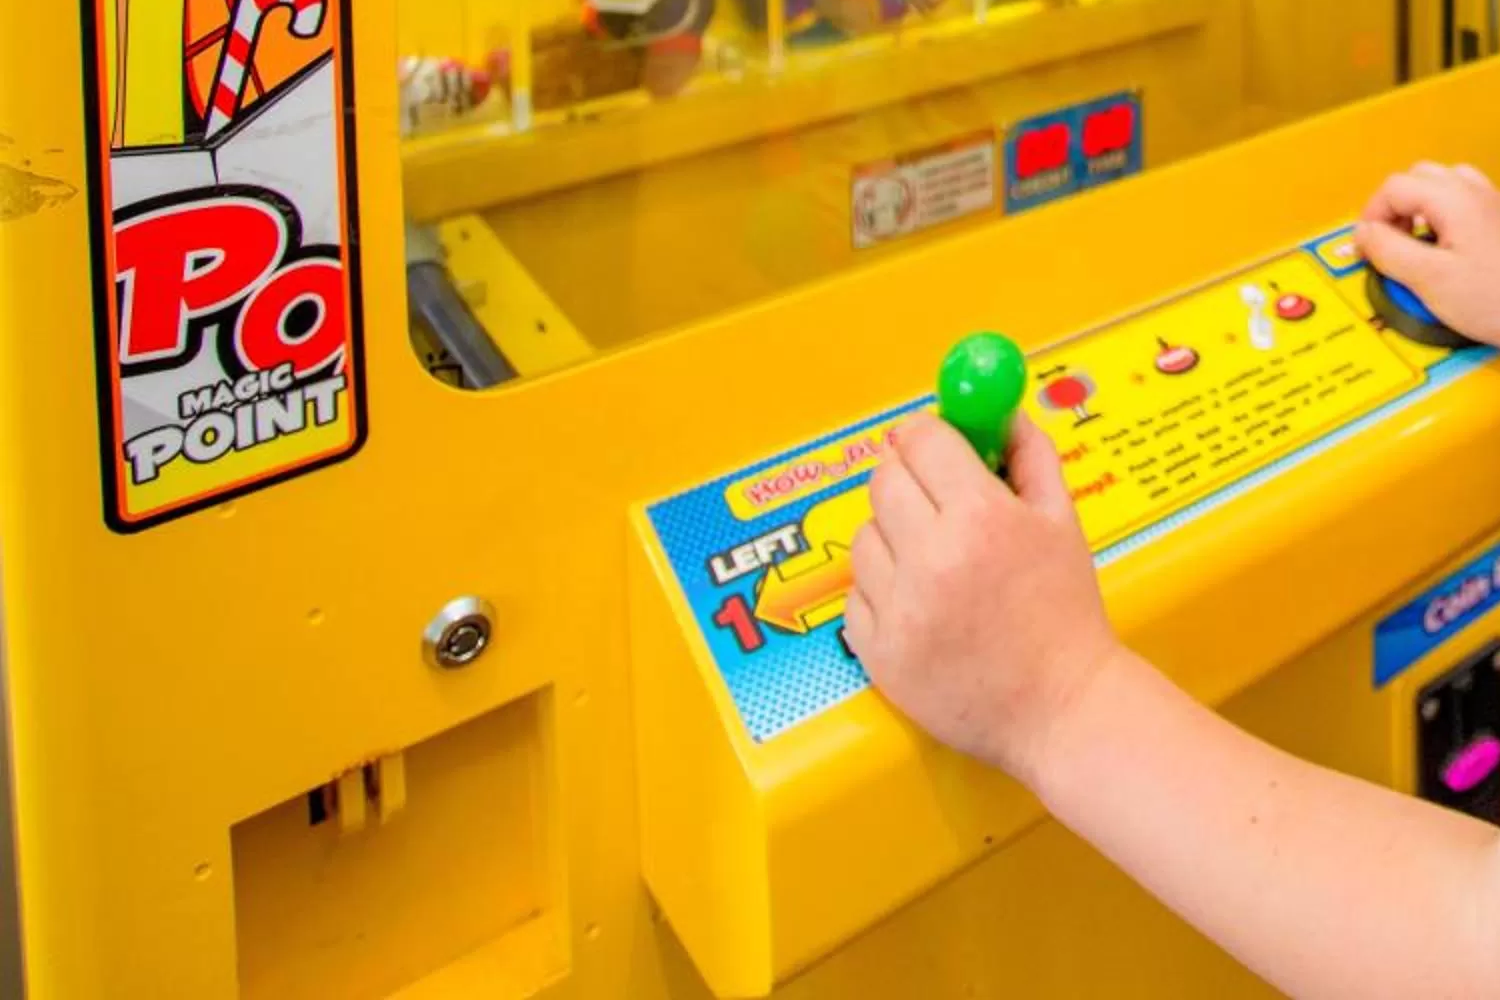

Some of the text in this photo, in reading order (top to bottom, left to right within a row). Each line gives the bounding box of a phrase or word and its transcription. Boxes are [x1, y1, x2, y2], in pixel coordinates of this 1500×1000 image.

[179, 361, 293, 418] MAGIC
[127, 376, 346, 483] POINT
[708, 523, 801, 586] LEFT
[713, 594, 765, 653] 1
[1423, 576, 1491, 633] Coin
